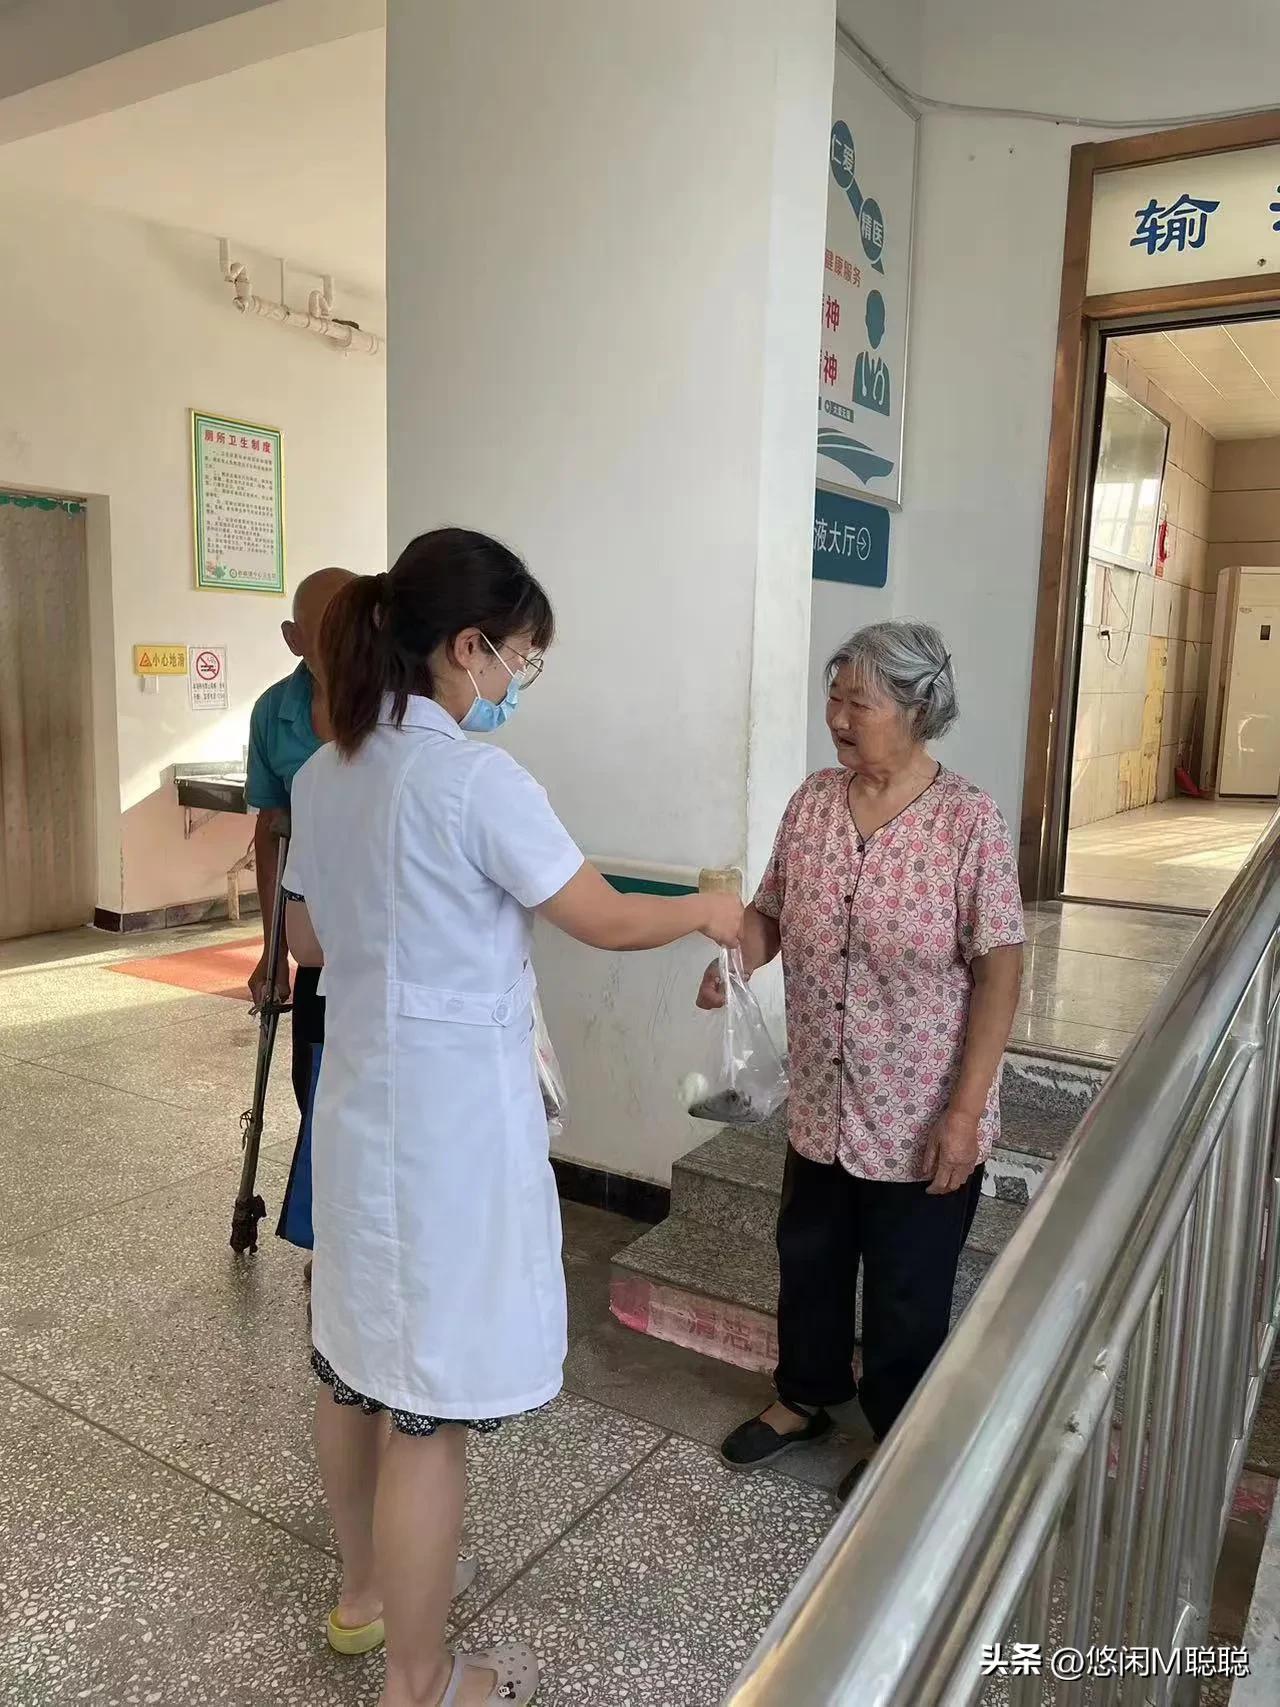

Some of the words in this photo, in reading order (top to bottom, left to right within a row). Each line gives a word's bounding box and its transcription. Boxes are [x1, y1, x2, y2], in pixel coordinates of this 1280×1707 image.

[1130, 184, 1280, 256] 输
[204, 429, 271, 453] 厕所卫生制度
